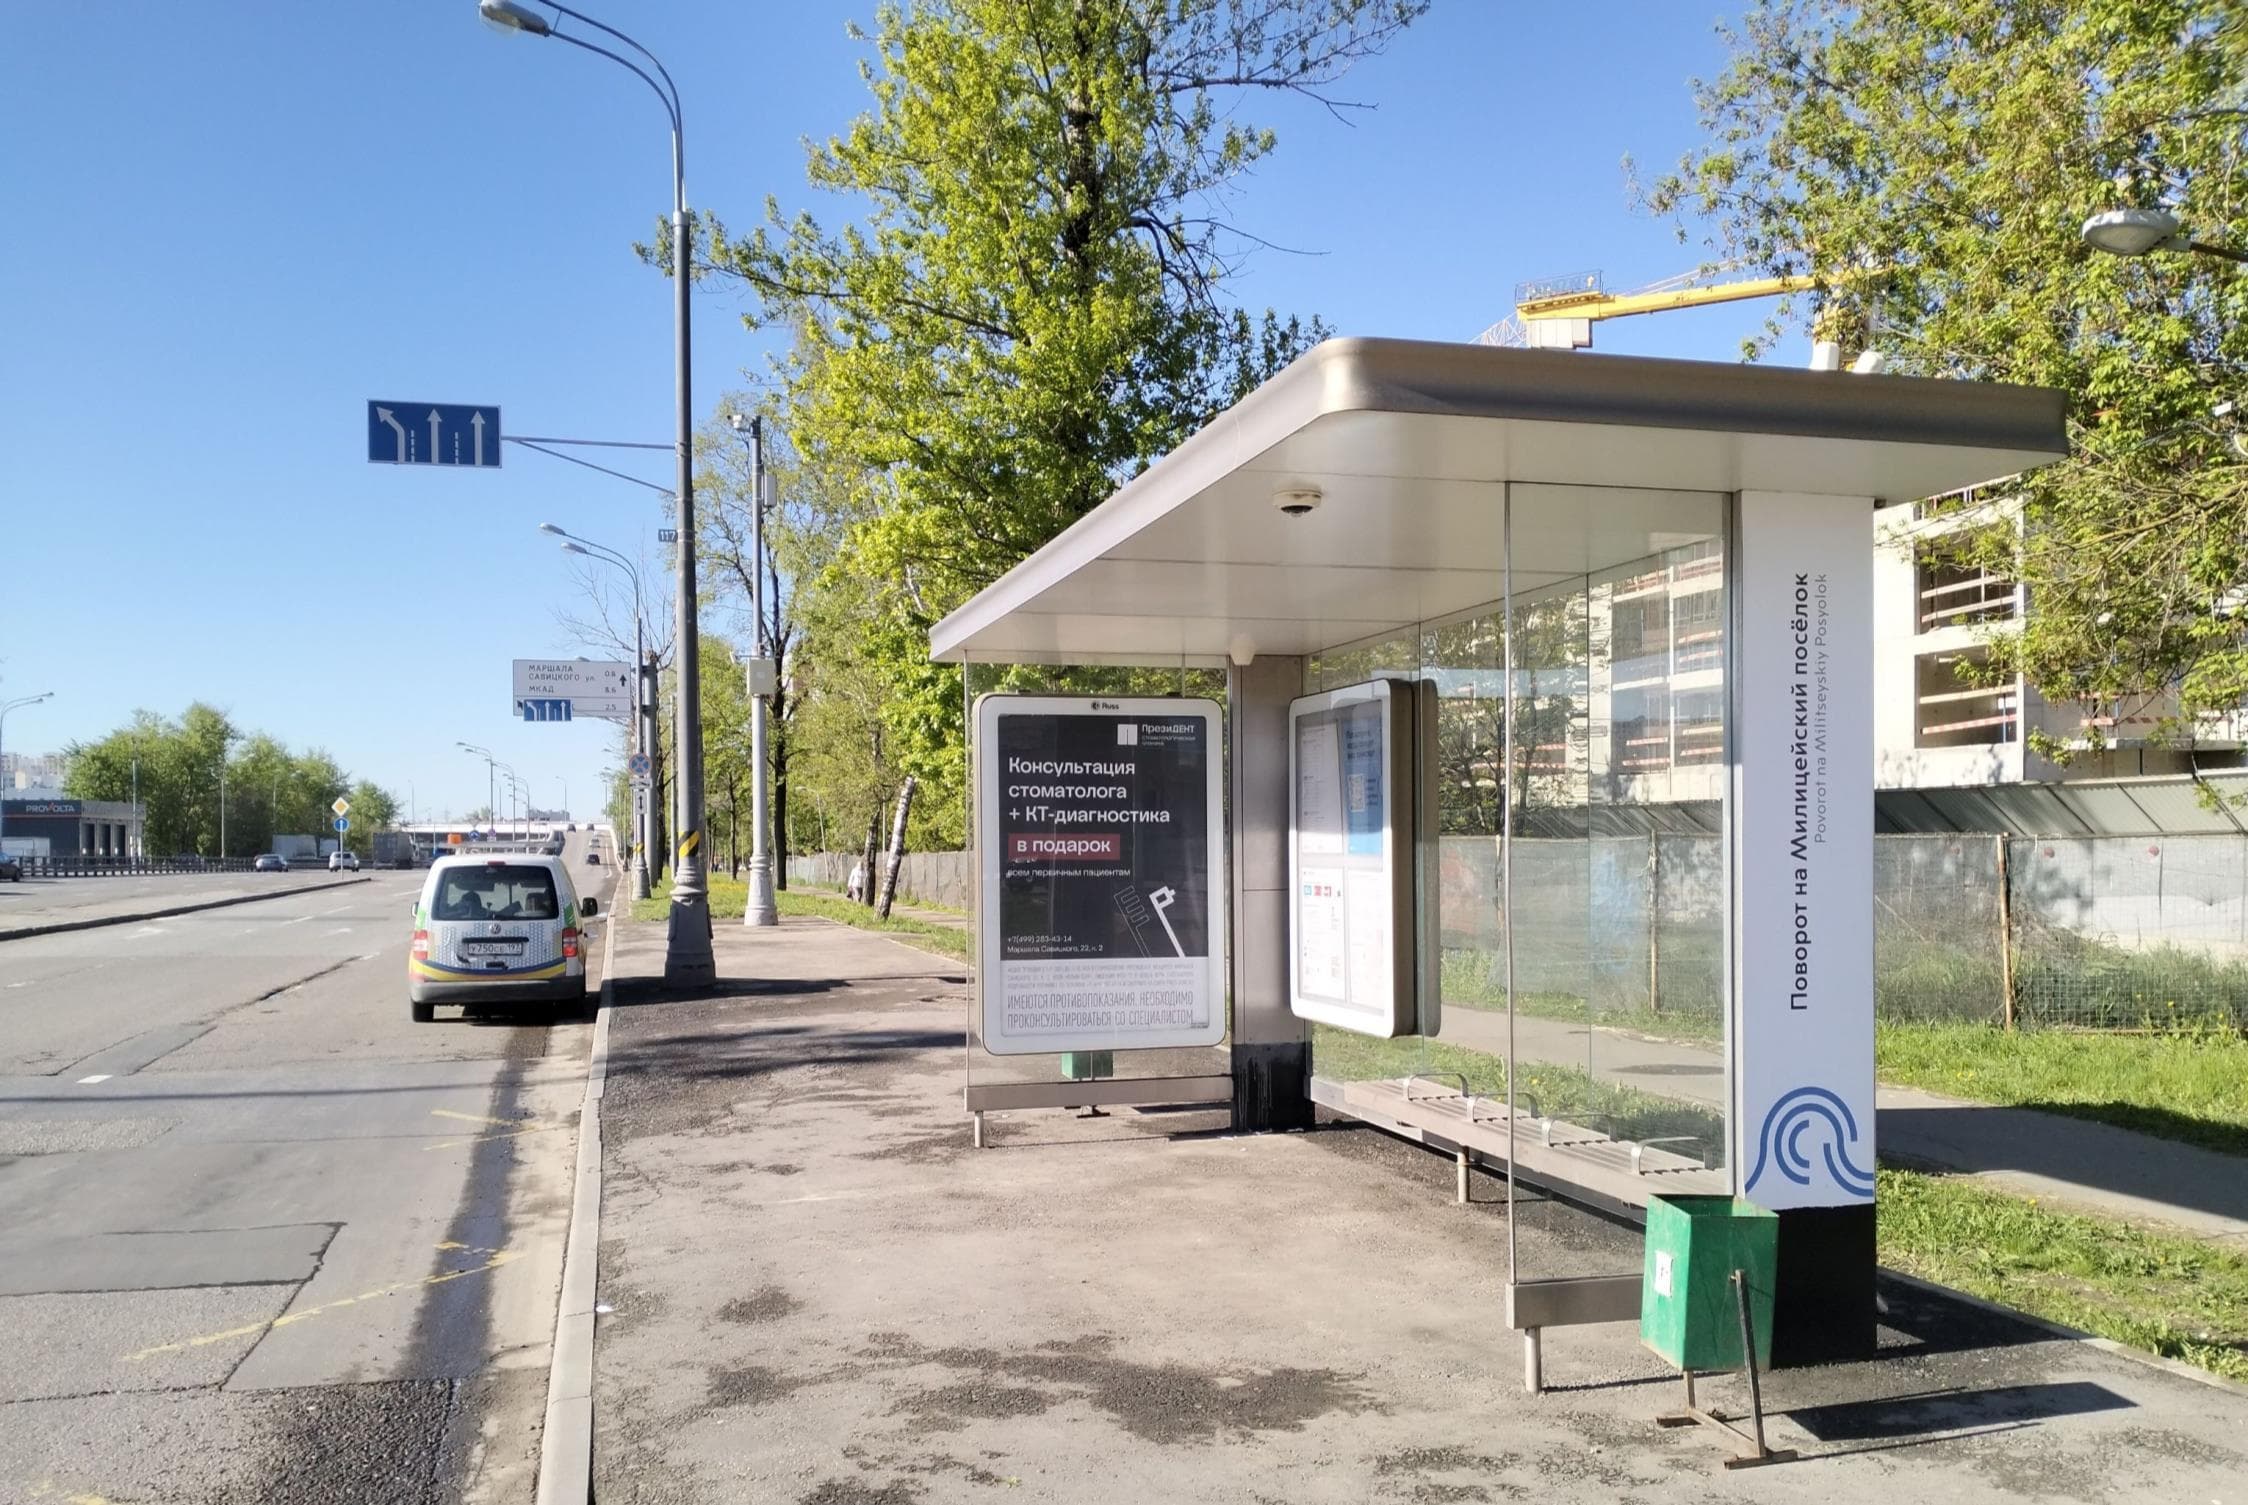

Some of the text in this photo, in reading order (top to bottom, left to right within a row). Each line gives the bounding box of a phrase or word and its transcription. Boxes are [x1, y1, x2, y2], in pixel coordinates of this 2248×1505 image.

[529, 673, 580, 681] САВИЦКОГО
[1102, 702, 1119, 710] Russ
[1814, 574, 1829, 843] Povorot na Militseyskiy Posyolok
[1142, 724, 1195, 734] ПрезиДЕНТ
[1009, 757, 1135, 777] Консультация
[1009, 785, 1127, 798] стоматолога
[1790, 573, 1811, 1010] Поворот на Милицейский посёлок
[26, 803, 75, 812] PROVOLTA
[1009, 806, 1170, 824] + КТ-диагностика
[1017, 839, 1110, 855] в подарок
[1032, 869, 1081, 878] первичным
[1083, 869, 1130, 877] пациентам
[1008, 993, 1048, 1009] ИМЕЮТСЯ
[1140, 991, 1193, 1006] НЕОБХОДИМО
[1008, 1010, 1193, 1029] ПРОКОНСУЛЬТИРОВАТЬСЯ СО СПЕЦИАЛИСТОМ
